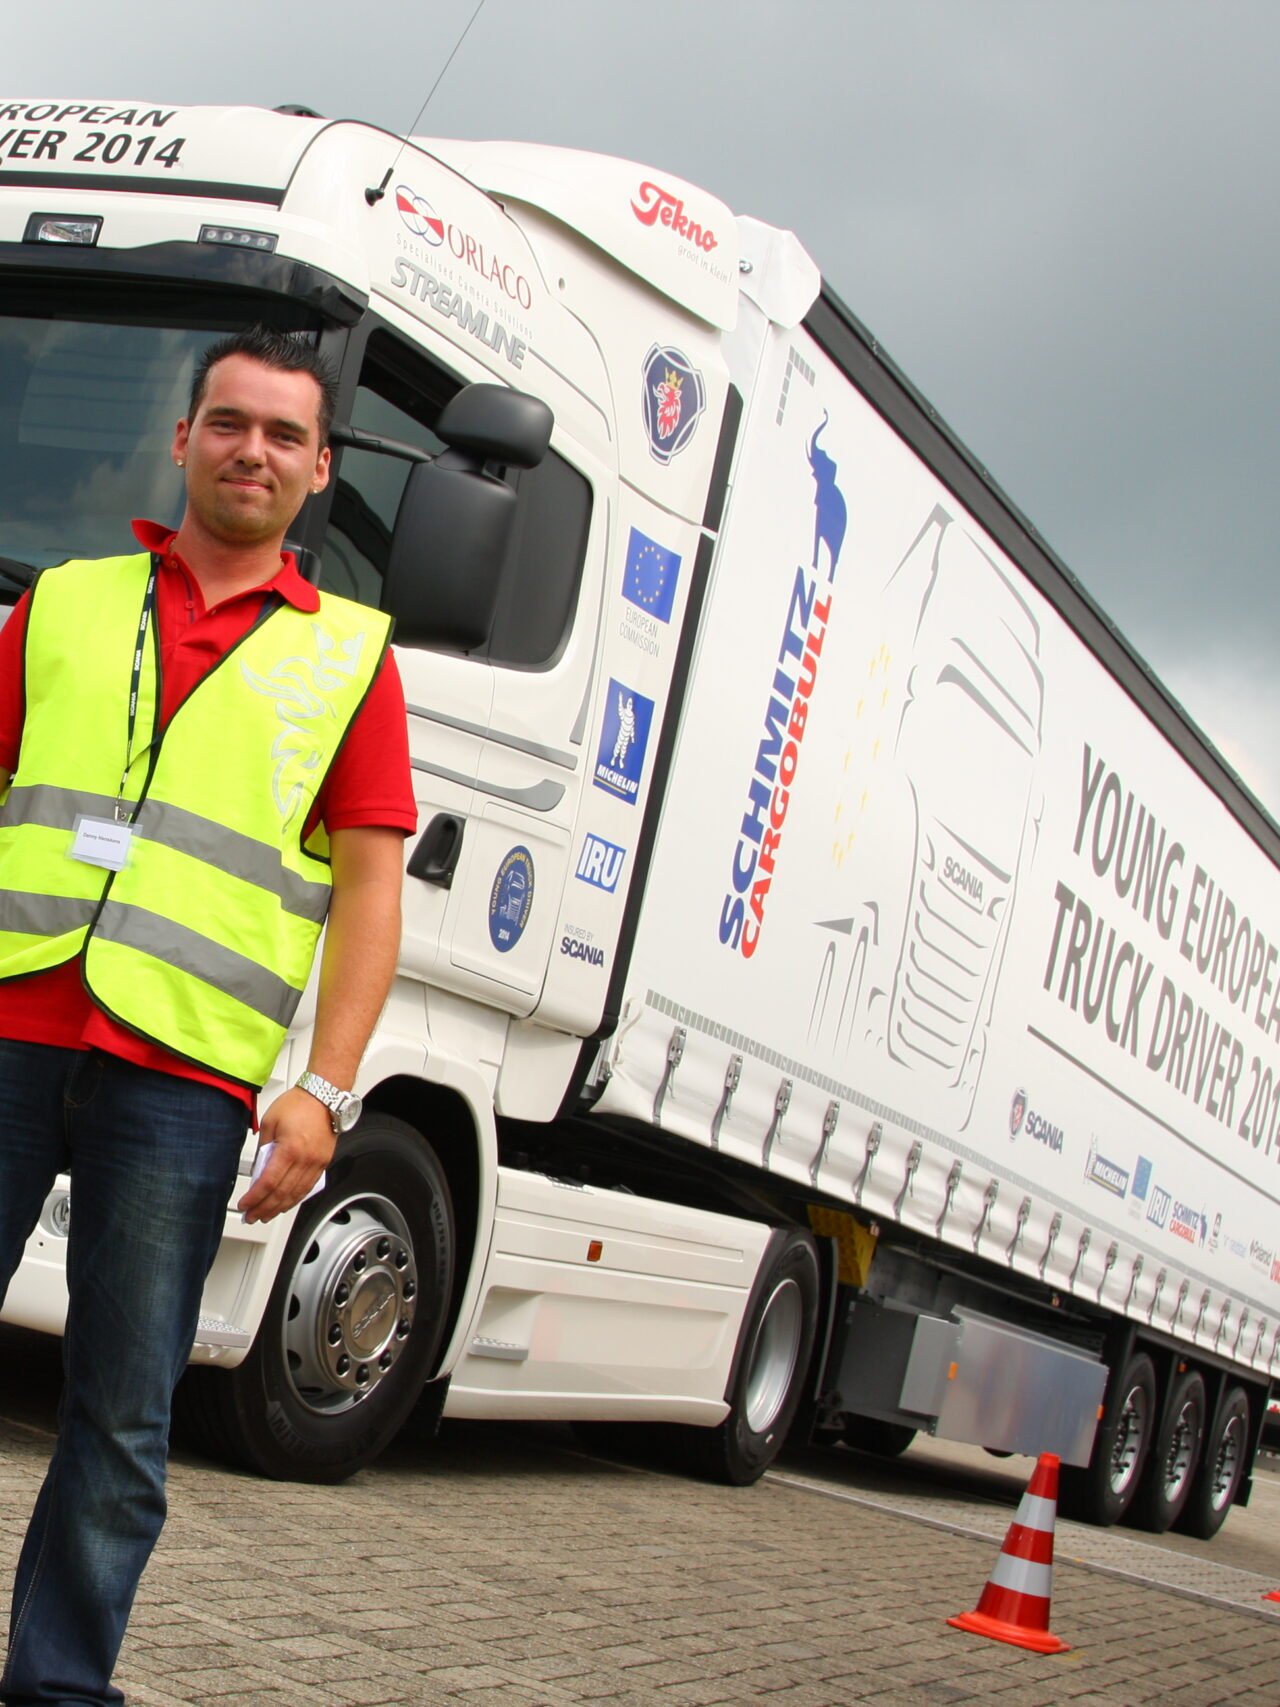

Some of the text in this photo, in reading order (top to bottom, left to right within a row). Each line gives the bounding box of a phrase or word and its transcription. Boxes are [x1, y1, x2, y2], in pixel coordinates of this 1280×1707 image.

[73, 132, 186, 168] 2014
[630, 181, 718, 252] Tekno
[396, 233, 533, 340] Specialised Camera Solutions
[448, 224, 531, 310] ORLACO
[390, 256, 527, 370] STREAMLINE
[620, 622, 661, 658] COMMISSION
[626, 606, 658, 638] EUROPEAN
[596, 764, 638, 794] MICHELIN
[719, 565, 817, 952] SCHMITZ
[740, 594, 832, 960] CARGOBULL
[578, 837, 624, 887] IRU
[1072, 740, 1186, 941] YOUNG
[943, 855, 983, 904] SCANIA
[560, 936, 604, 968] SCANIA
[1043, 879, 1155, 1059] TRUCK
[1146, 975, 1244, 1130] DRIVER
[1025, 1110, 1064, 1155] SCANIA
[1093, 1160, 1128, 1191] MICHELIN
[1148, 1187, 1171, 1227] IRU
